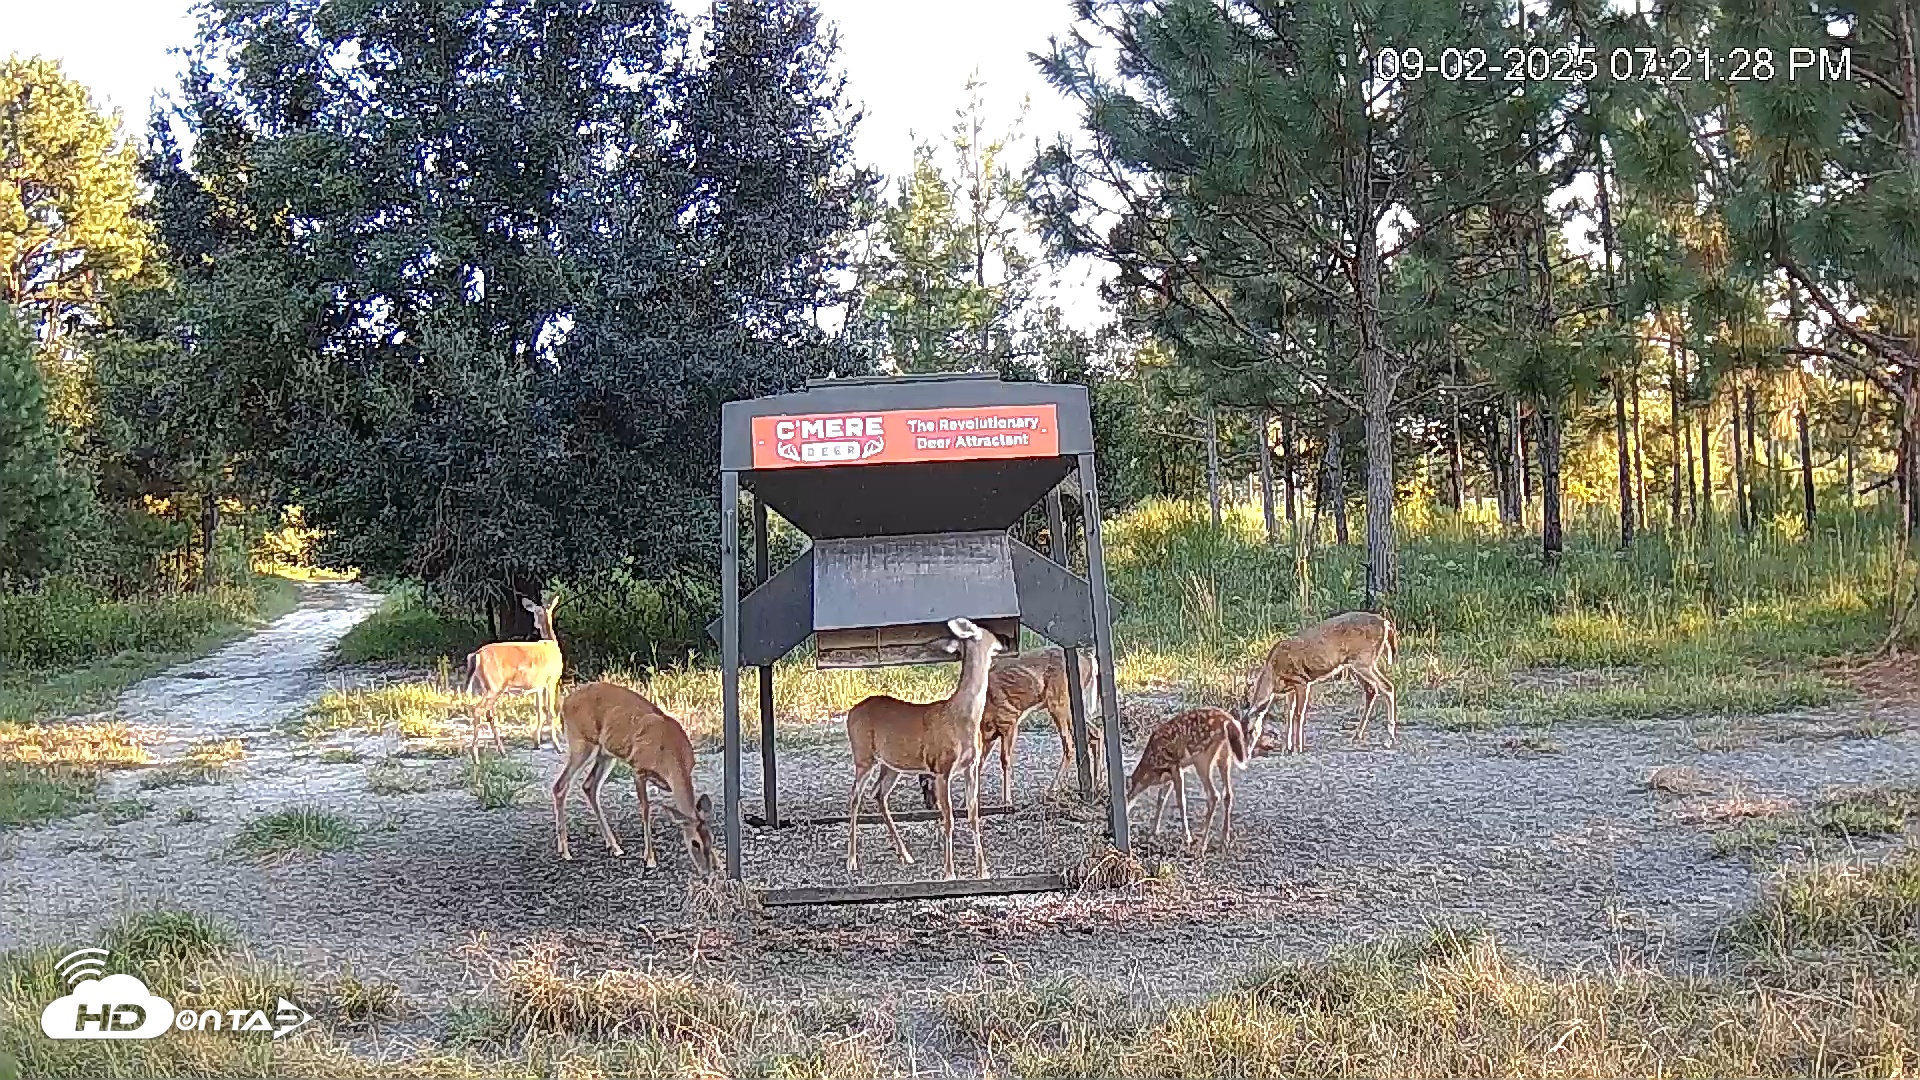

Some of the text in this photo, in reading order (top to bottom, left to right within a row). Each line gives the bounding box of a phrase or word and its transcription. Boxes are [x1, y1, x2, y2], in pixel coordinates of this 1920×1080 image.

[776, 417, 884, 440] C'MERE
[907, 416, 1038, 432] The Revolutionary
[917, 433, 1029, 450] Deer Attractant
[807, 446, 855, 457] DEER
